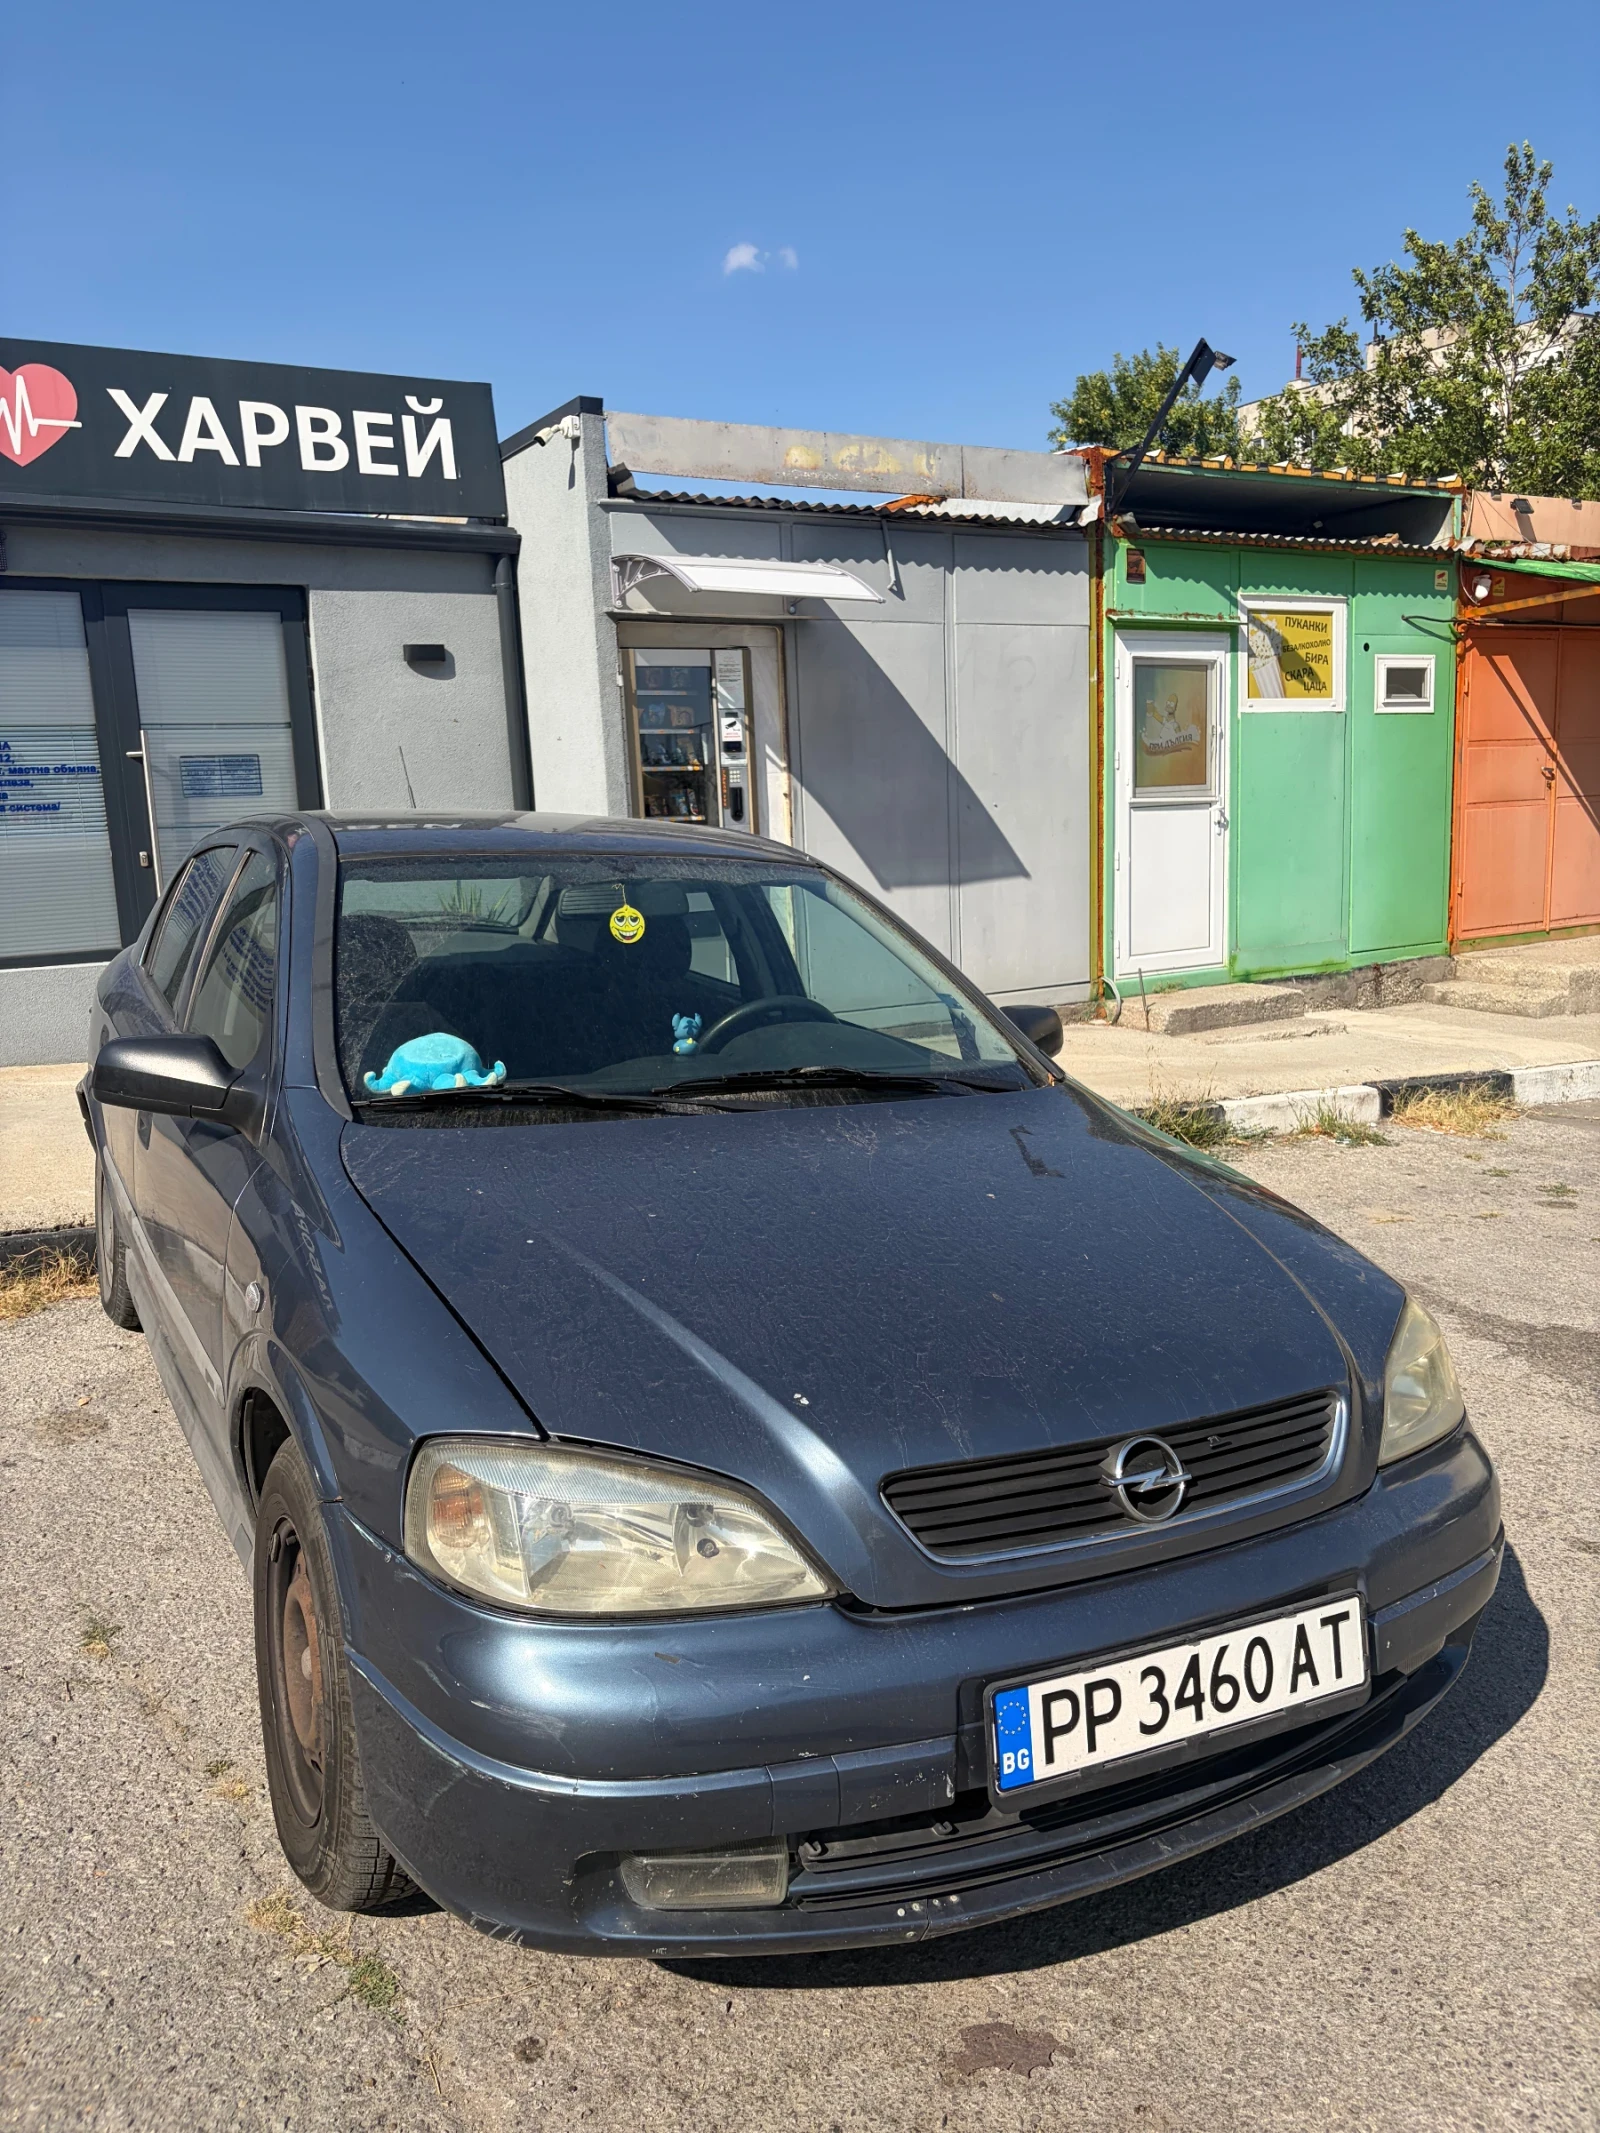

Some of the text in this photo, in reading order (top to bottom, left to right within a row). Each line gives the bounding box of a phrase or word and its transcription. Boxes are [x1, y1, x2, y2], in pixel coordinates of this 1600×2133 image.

[106, 388, 458, 480] ХАРВЕЙ
[1285, 616, 1328, 634] ПУКАНКИ
[1282, 639, 1331, 653] БЕЗАЛКОХОЛНО
[1305, 652, 1329, 665] БИРА
[1285, 667, 1315, 682] СКАРА
[1303, 681, 1327, 694] ЦАЦА
[1149, 742, 1163, 751] ПРИ
[8, 766, 51, 775] мастна
[1041, 1610, 1351, 1766] PP 3460 AT
[1002, 1748, 1030, 1775] BG
